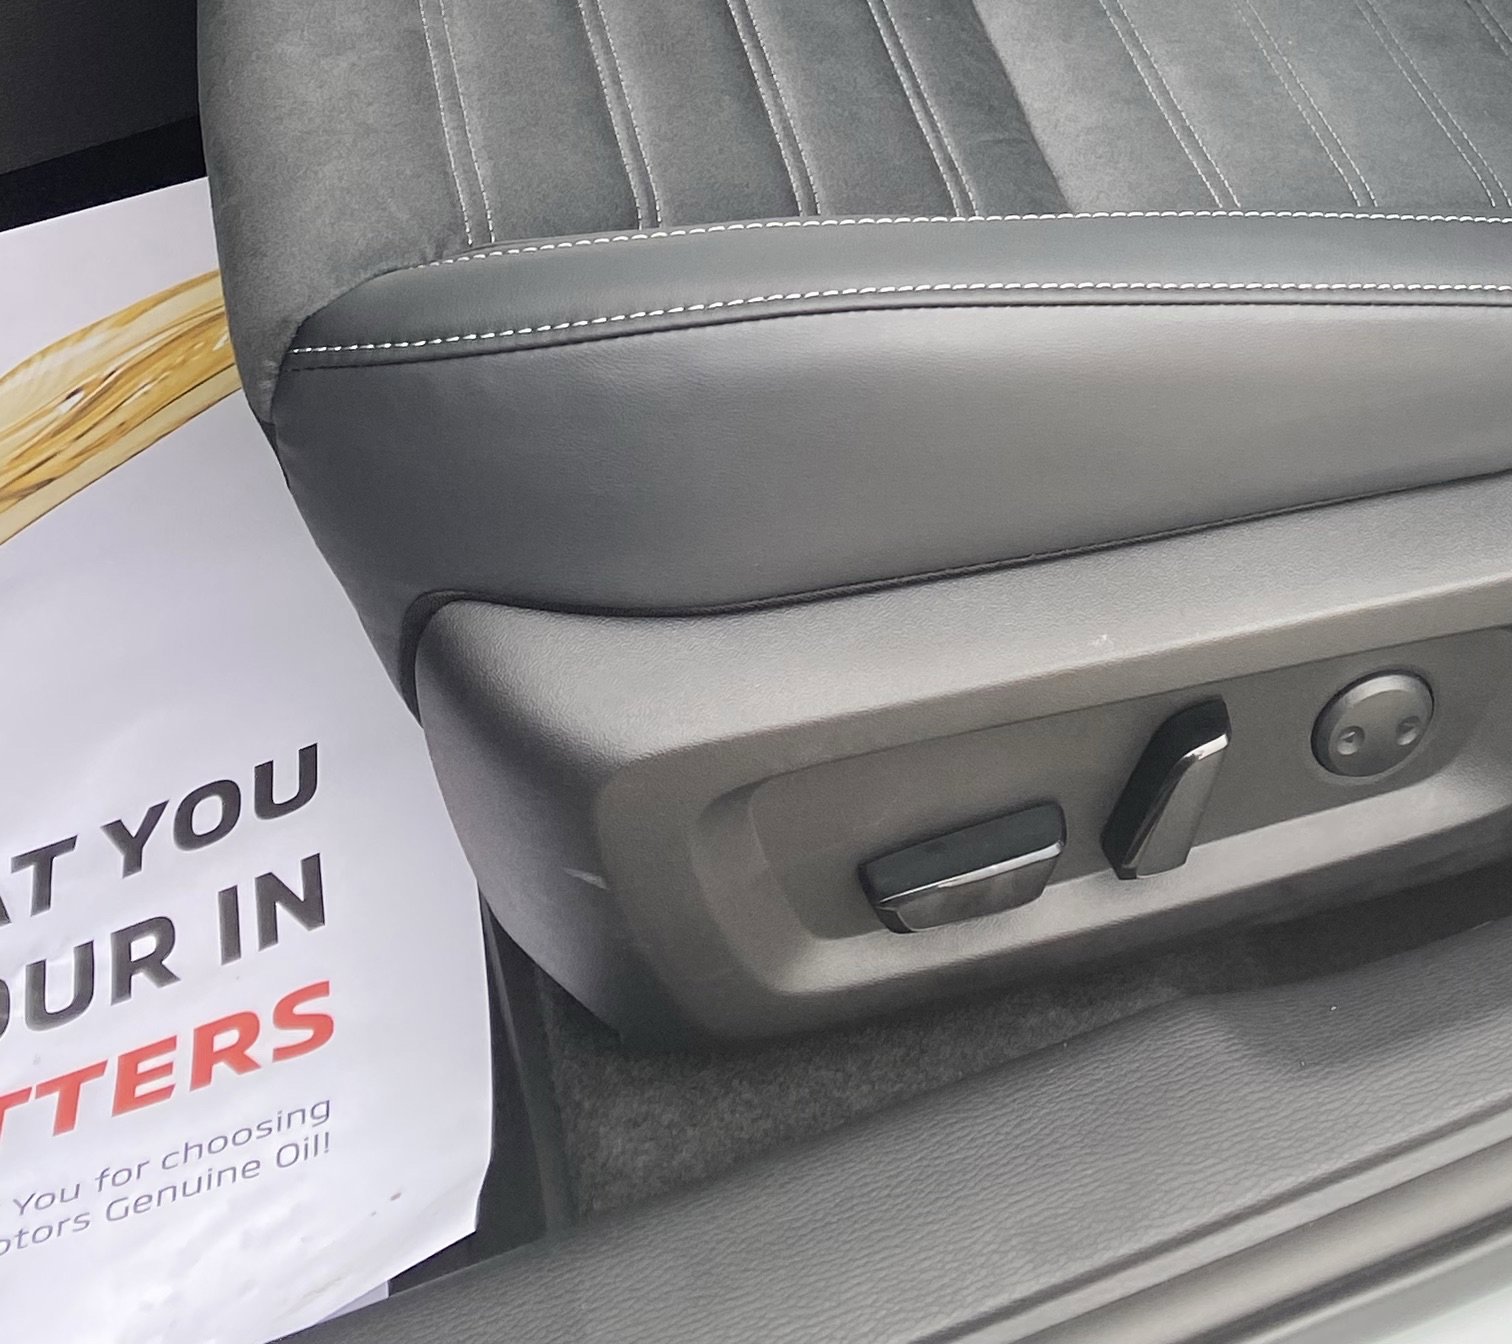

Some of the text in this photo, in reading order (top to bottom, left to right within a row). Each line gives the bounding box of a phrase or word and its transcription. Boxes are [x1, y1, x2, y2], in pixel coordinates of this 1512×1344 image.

[0, 743, 318, 927] T YOU
[0, 853, 325, 1035] UR IN
[13, 1099, 330, 1216] You for choosing
[106, 1159, 261, 1221] Genuine
[276, 1132, 330, 1169] Oil!
